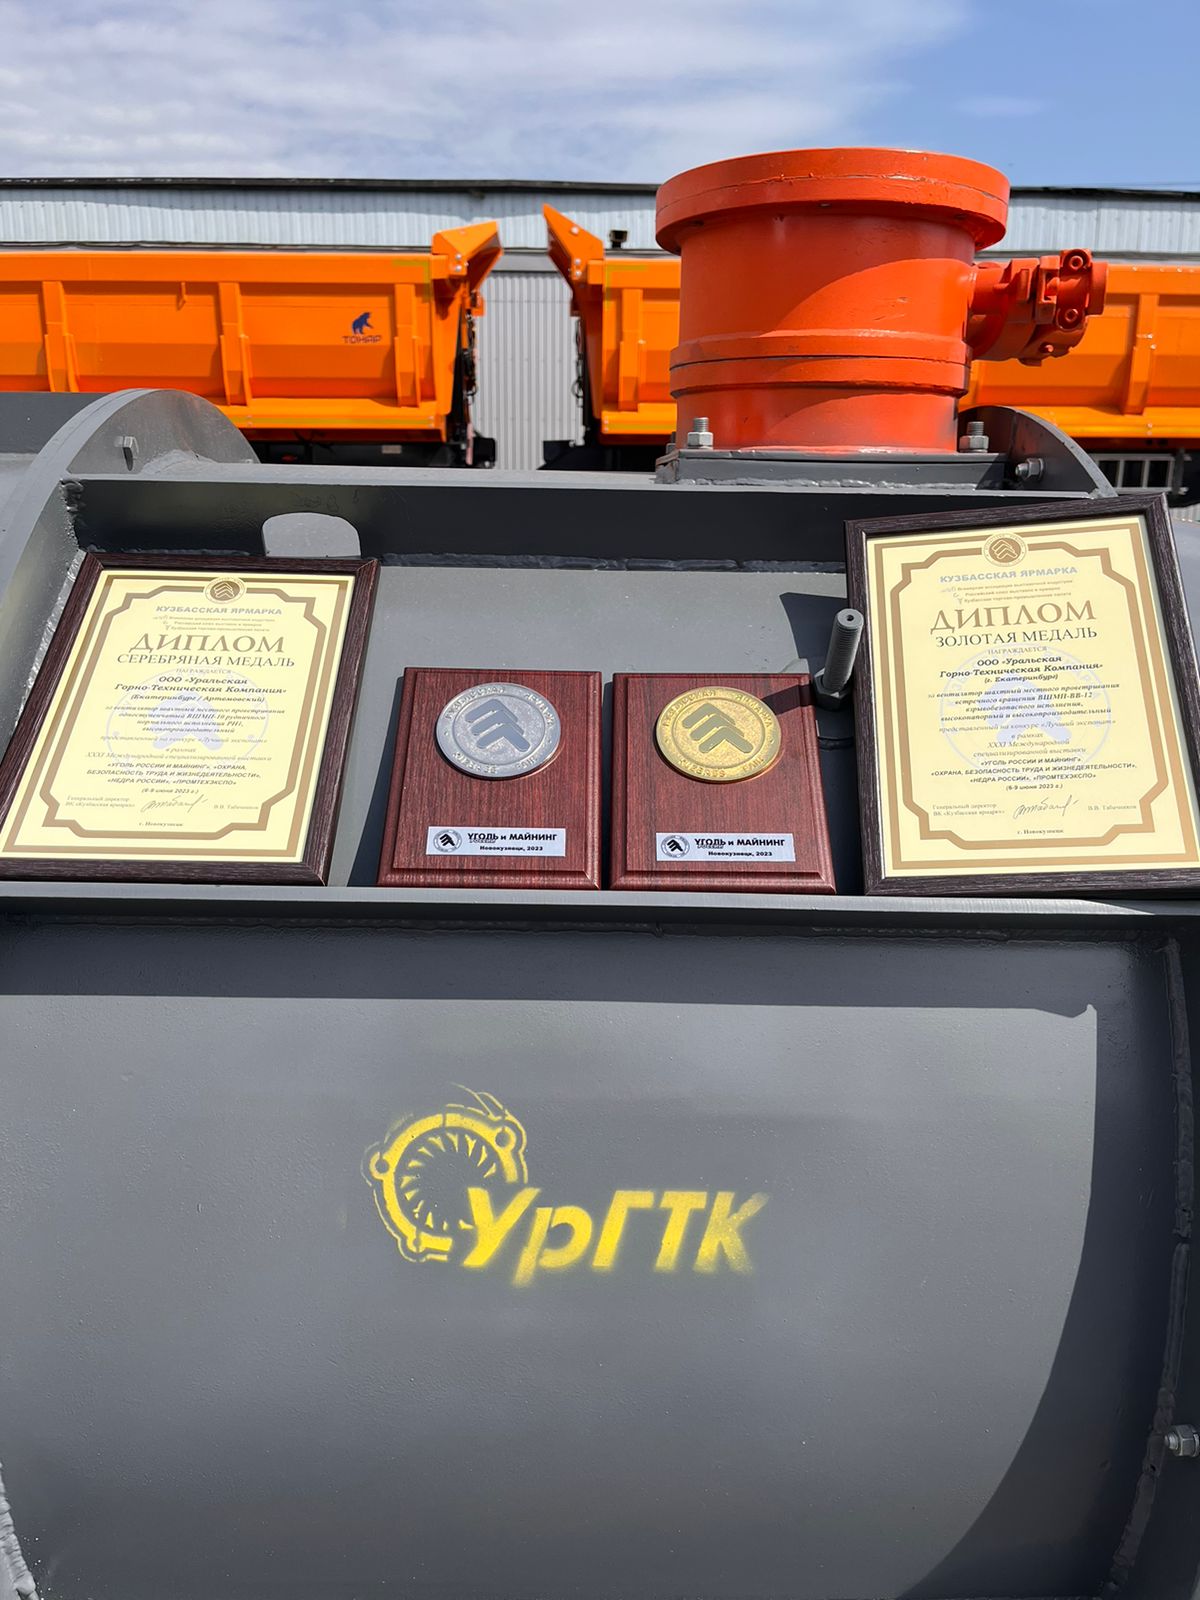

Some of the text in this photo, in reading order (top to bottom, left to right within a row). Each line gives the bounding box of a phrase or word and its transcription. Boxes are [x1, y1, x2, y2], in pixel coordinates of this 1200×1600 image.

[940, 566, 1078, 583] КУЗБАССКАЯ ЯРМАРКА
[156, 605, 228, 614] КУЗБАССКАЯ
[930, 600, 1097, 635] ДИПЛОМ
[936, 626, 1098, 648] ЗОЛОТАЯ МЕДАЛЬ
[129, 633, 284, 654] ДИПЛОМ
[987, 646, 1048, 656] НАГРАЖДАЕТСЯ
[117, 654, 295, 668] СЕРЕБРЯНАЯ МЕДАЛЬ
[977, 658, 1000, 667] ООО
[940, 666, 1041, 678] Горно-Техническая
[995, 674, 1059, 683] Екатеринбург)
[114, 684, 222, 693] Горно-Техническая
[1008, 758, 1037, 766] РОССИИ
[964, 767, 1020, 776] БЕЗОПАСНОСТЬ
[1022, 766, 1044, 774] ТРУДА
[467, 832, 499, 840] УГОЛЬ
[509, 832, 558, 841] МАЙНИНГ
[694, 838, 726, 846] УГОЛЬ
[736, 838, 786, 846] МАЙНИНГ
[463, 1186, 770, 1287] УрГТК
